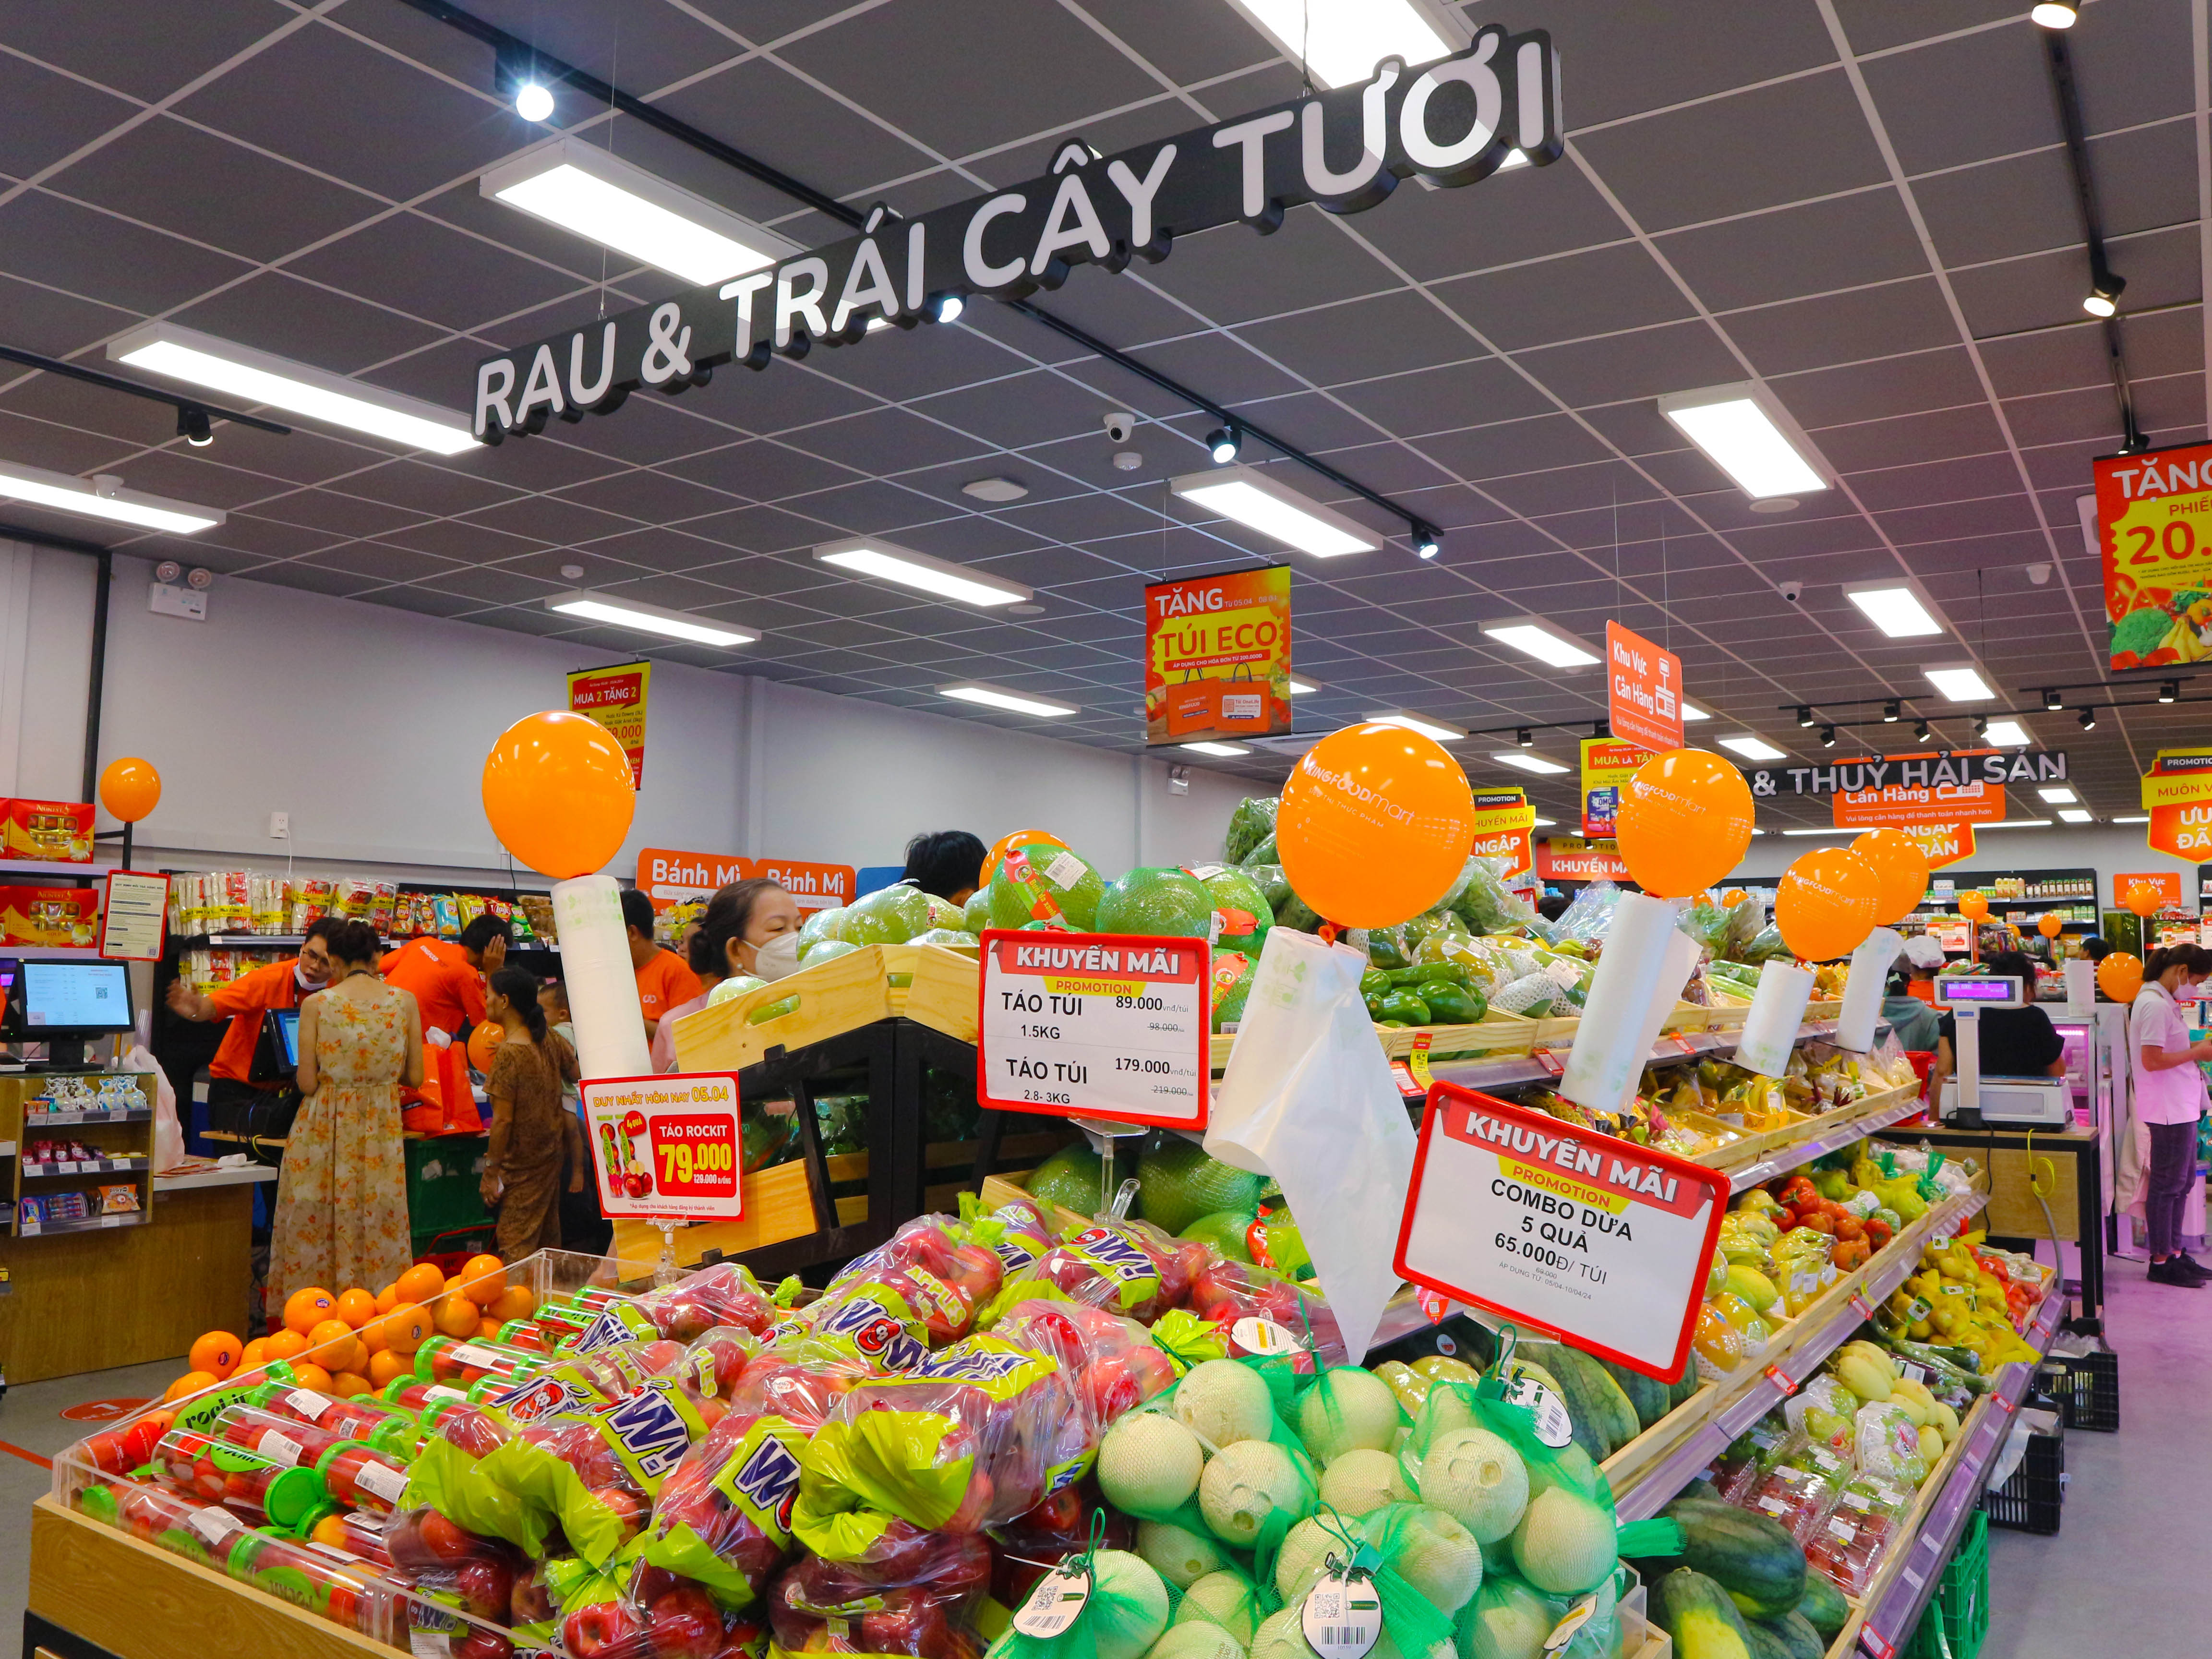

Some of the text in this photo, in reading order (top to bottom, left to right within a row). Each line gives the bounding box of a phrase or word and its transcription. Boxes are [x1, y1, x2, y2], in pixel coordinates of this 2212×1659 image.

[475, 32, 1544, 435] RAU & TRÁI CÂY TƯƠI
[2169, 495, 2212, 517] PHIẾ
[1154, 586, 1223, 620] TẶNG
[1158, 621, 1277, 657] TÚI ECO
[1614, 640, 1647, 679] Khu Vực
[574, 686, 637, 705] MUA 2 TẶNG 2
[1615, 674, 1654, 715] Cân Hàng
[1595, 756, 1620, 765] MUA
[1623, 756, 1633, 764] LÀ
[1755, 746, 2067, 796] & THUỶ HẢI SẢN
[1305, 764, 1416, 826] KINGFOODmart
[1599, 797, 1613, 806] OMO
[1884, 787, 1929, 803] Hàng
[2158, 783, 2200, 797] MUÔN
[1475, 813, 1528, 828] HUYẾN MÃI
[1859, 813, 1874, 822] lòng
[1874, 813, 1887, 821] cân
[1887, 811, 1905, 821] hàng
[1906, 810, 1915, 819] để
[1916, 811, 1936, 819] thanh
[1955, 809, 1976, 817] nhanh
[1977, 807, 1992, 816] hơn
[1474, 834, 1521, 855] NGẬP
[1919, 839, 1959, 859] RÀN
[652, 858, 741, 887] Bánh Mì
[1552, 856, 1608, 873] KHUYẾN
[768, 867, 844, 895] Bánh Mì
[1792, 874, 1856, 906] KINGFOODmart
[2148, 878, 2166, 890] Vực
[494, 904, 510, 914] Lay's
[1038, 892, 1046, 902] da
[1043, 902, 1057, 917] xanh
[1016, 944, 1179, 975] KHUYẾN MÃI
[1056, 980, 1132, 994] PROMOTION
[1001, 989, 1043, 1013] TÁO
[1049, 993, 1082, 1016] TÚI
[1021, 1024, 1061, 1039] 1.5KG
[1006, 1056, 1048, 1080] TÁO
[1054, 1060, 1088, 1084] TÚI
[593, 1086, 729, 1107] DUY NHẤT HÔM NAY 05.04
[1024, 1089, 1043, 1101] 2.8-
[1046, 1091, 1070, 1105] 3KG
[626, 1116, 643, 1129] 4 QUẢ
[659, 1122, 728, 1138] TÁO ROCKIT
[658, 1142, 732, 1183] 79.000
[1465, 1111, 1678, 1202] KHUYẾN MÃI
[693, 1174, 717, 1184] 129.000
[1512, 1165, 1611, 1208] PROMOTION
[1491, 1178, 1633, 1242] COMBO DỪA
[1520, 1216, 1589, 1253] 5 QUẢ
[1494, 1233, 1608, 1285] 65.000Đ/ TÚI
[1499, 1261, 1508, 1270] ÁP
[1509, 1263, 1531, 1278] DỤNG
[1544, 1277, 1593, 1300] 05/04-10/04/24
[1536, 1267, 1558, 1280] 69.000
[902, 1264, 967, 1328] APPLES
